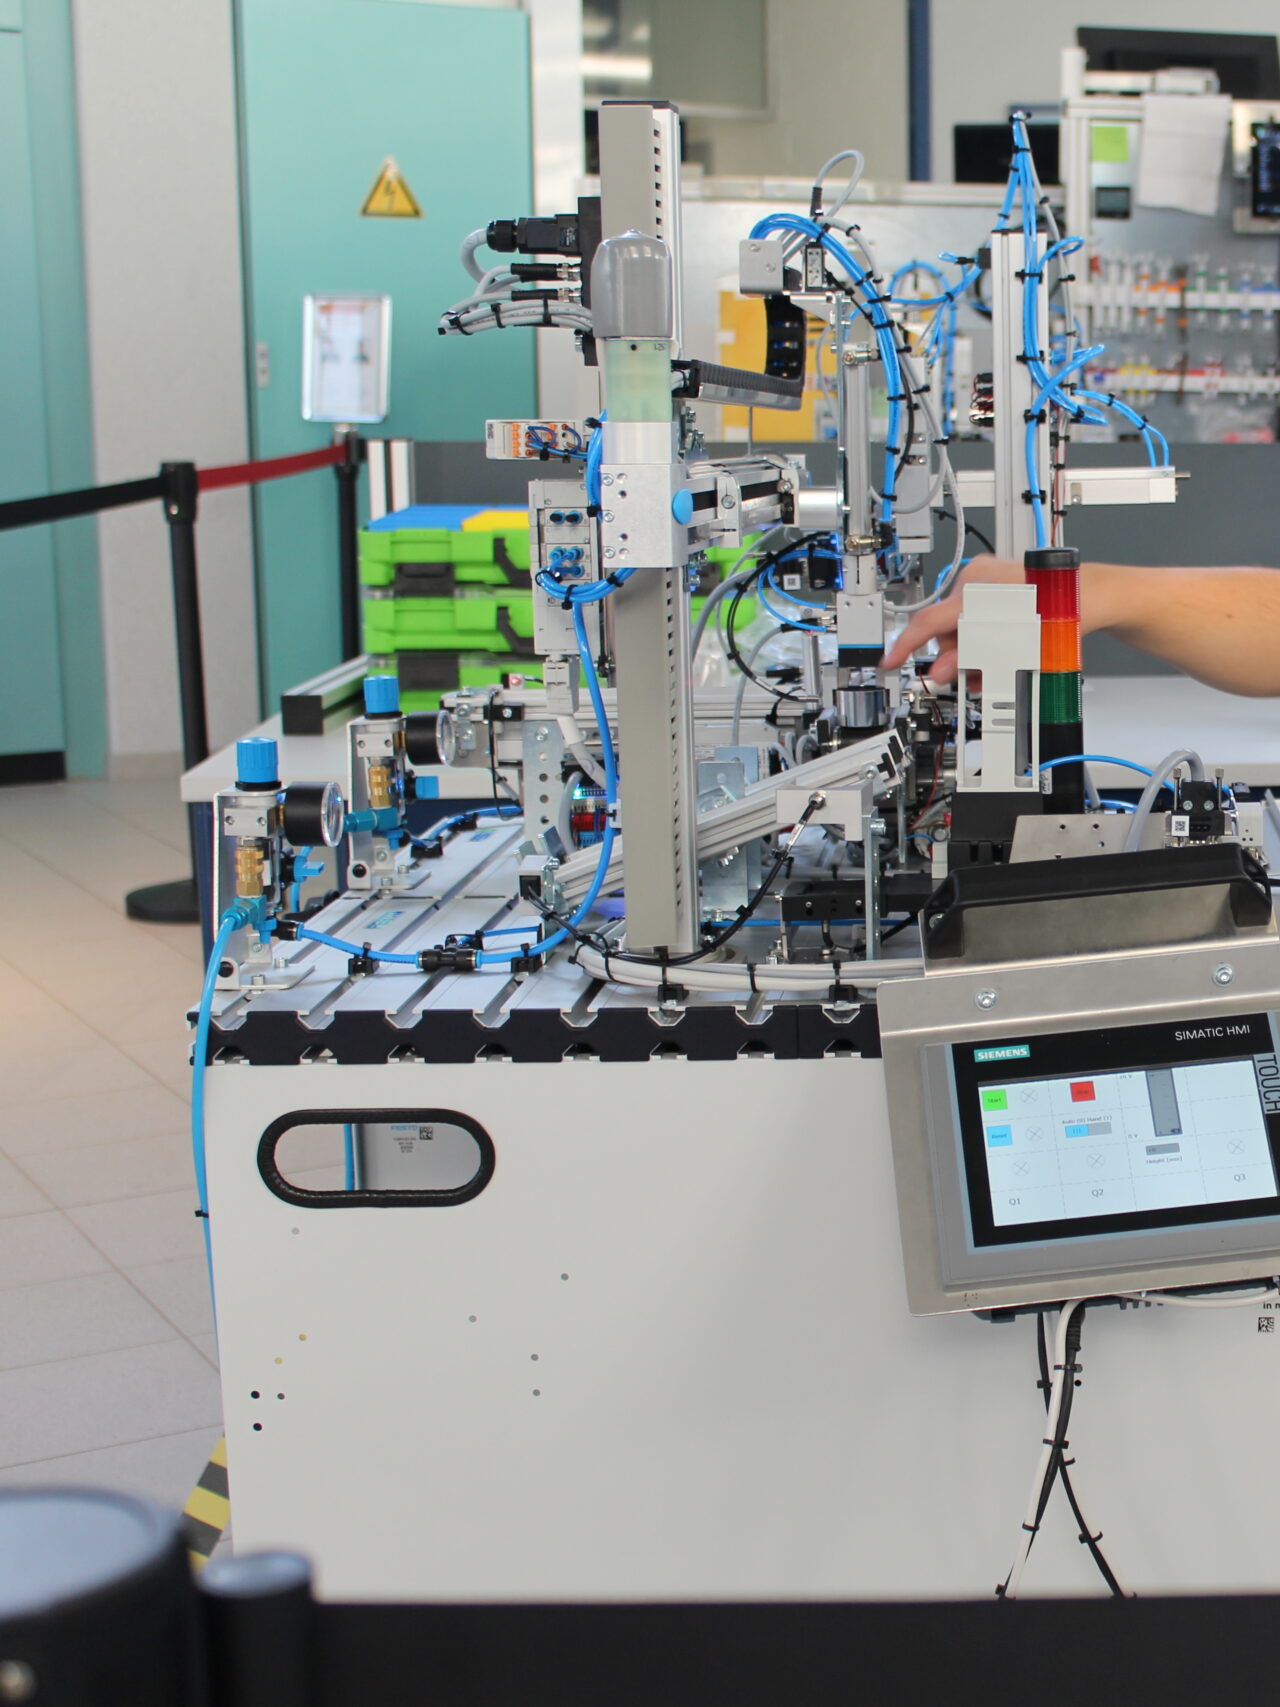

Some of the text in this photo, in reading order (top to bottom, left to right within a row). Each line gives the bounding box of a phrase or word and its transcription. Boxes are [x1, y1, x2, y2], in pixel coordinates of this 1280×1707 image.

[1175, 1024, 1250, 1041] SIMATIC HMI
[977, 1048, 1028, 1060] SIEMENS
[1234, 1173, 1246, 1182] Q3
[1092, 1189, 1104, 1197] Q2
[1009, 1197, 1021, 1206] Q1
